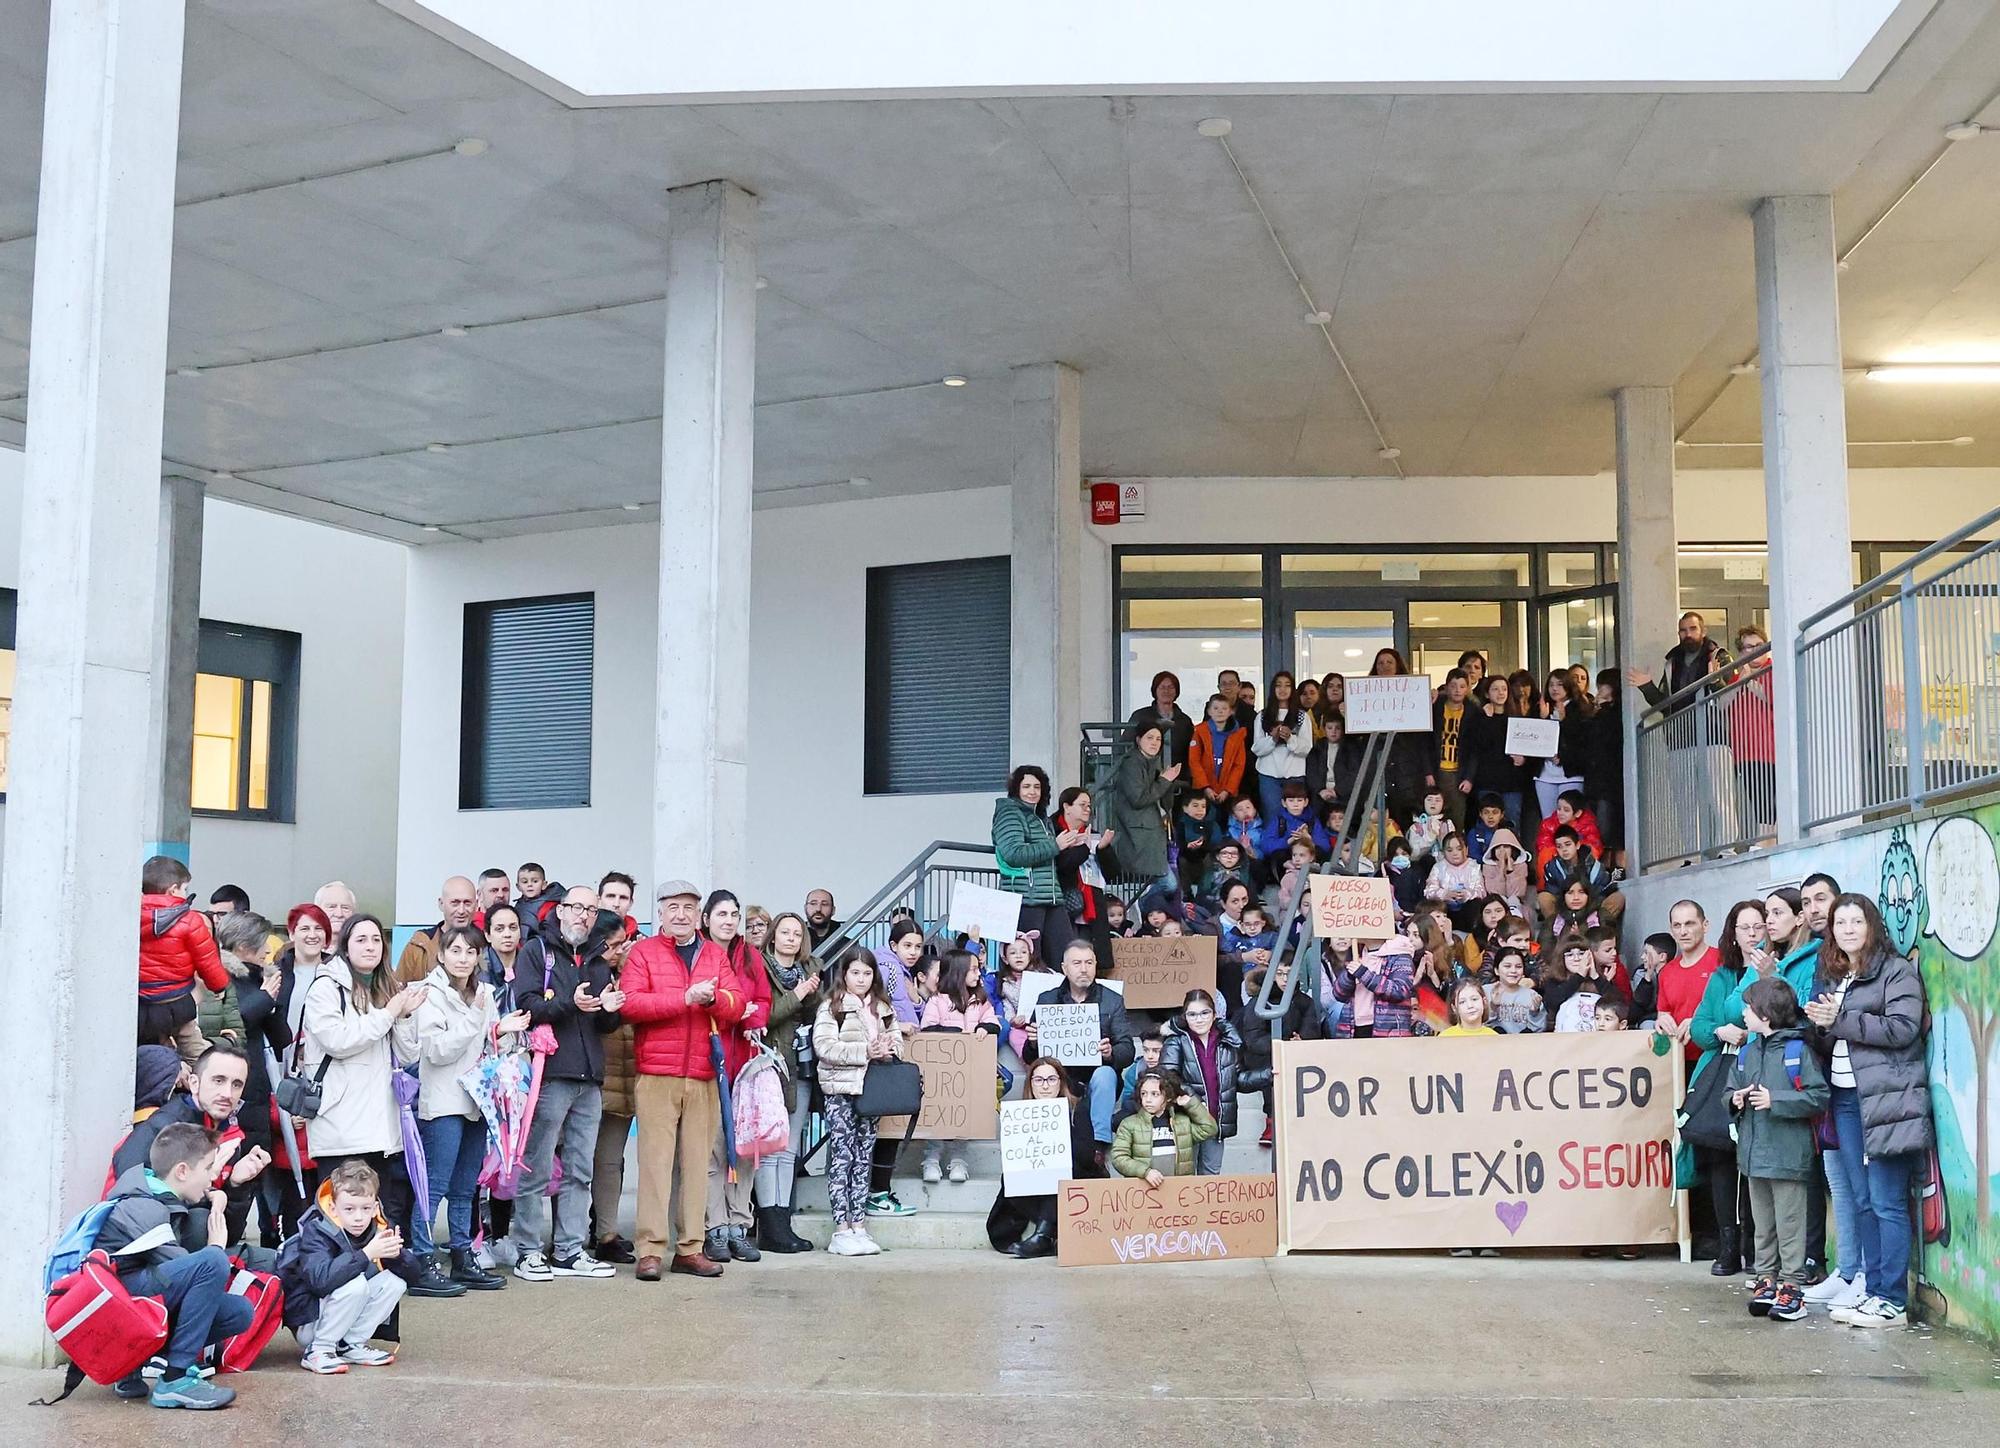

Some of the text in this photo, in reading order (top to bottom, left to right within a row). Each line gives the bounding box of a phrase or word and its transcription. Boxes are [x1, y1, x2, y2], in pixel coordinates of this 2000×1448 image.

[1329, 880, 1371, 893] ACCESO
[1347, 896, 1387, 911] COLEGIO
[1116, 943, 1163, 954] ACCESO
[1115, 957, 1159, 968] SEGURO
[1127, 971, 1189, 984] COLEXIO
[1041, 1005, 1086, 1017] POR UN
[1038, 1015, 1100, 1028] ACCESO AL
[1043, 1028, 1092, 1039] COLEGIO
[903, 1038, 967, 1065] CESO
[922, 1070, 965, 1098] URO
[1295, 1065, 1653, 1118] POR UN ACCESO
[1002, 1104, 1061, 1122] ACCESO
[1004, 1121, 1059, 1136] SEGURO
[1027, 1135, 1043, 1145] AL
[1006, 1143, 1065, 1161] COLEGIO
[1030, 1159, 1046, 1169] YA
[1296, 1158, 1343, 1202] AO
[1558, 1139, 1672, 1188] SEGURO
[1067, 1179, 1276, 1217] 5 ANOS ESPERANDO
[1072, 1208, 1265, 1236] POR UN ACCESO SEGURO
[1110, 1230, 1228, 1263] VERGONA
